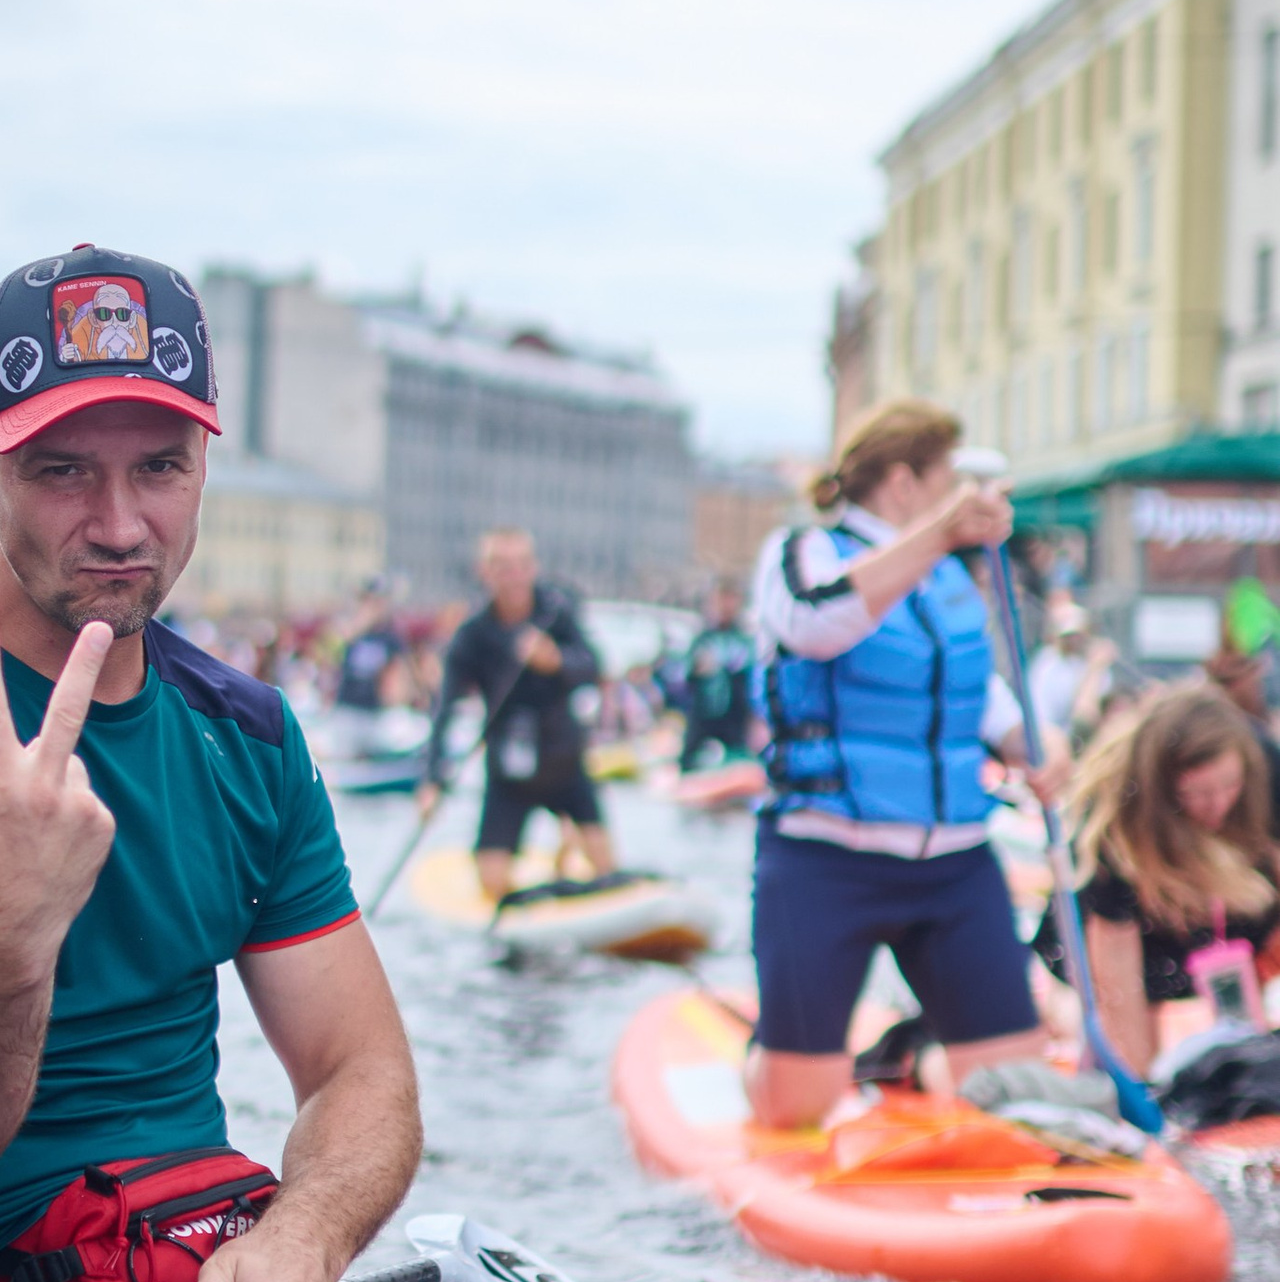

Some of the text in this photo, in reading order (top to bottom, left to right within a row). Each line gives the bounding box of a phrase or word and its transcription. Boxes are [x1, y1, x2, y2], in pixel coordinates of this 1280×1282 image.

[57, 280, 107, 293] KAME SENNIN
[167, 1214, 256, 1238] ONVER
